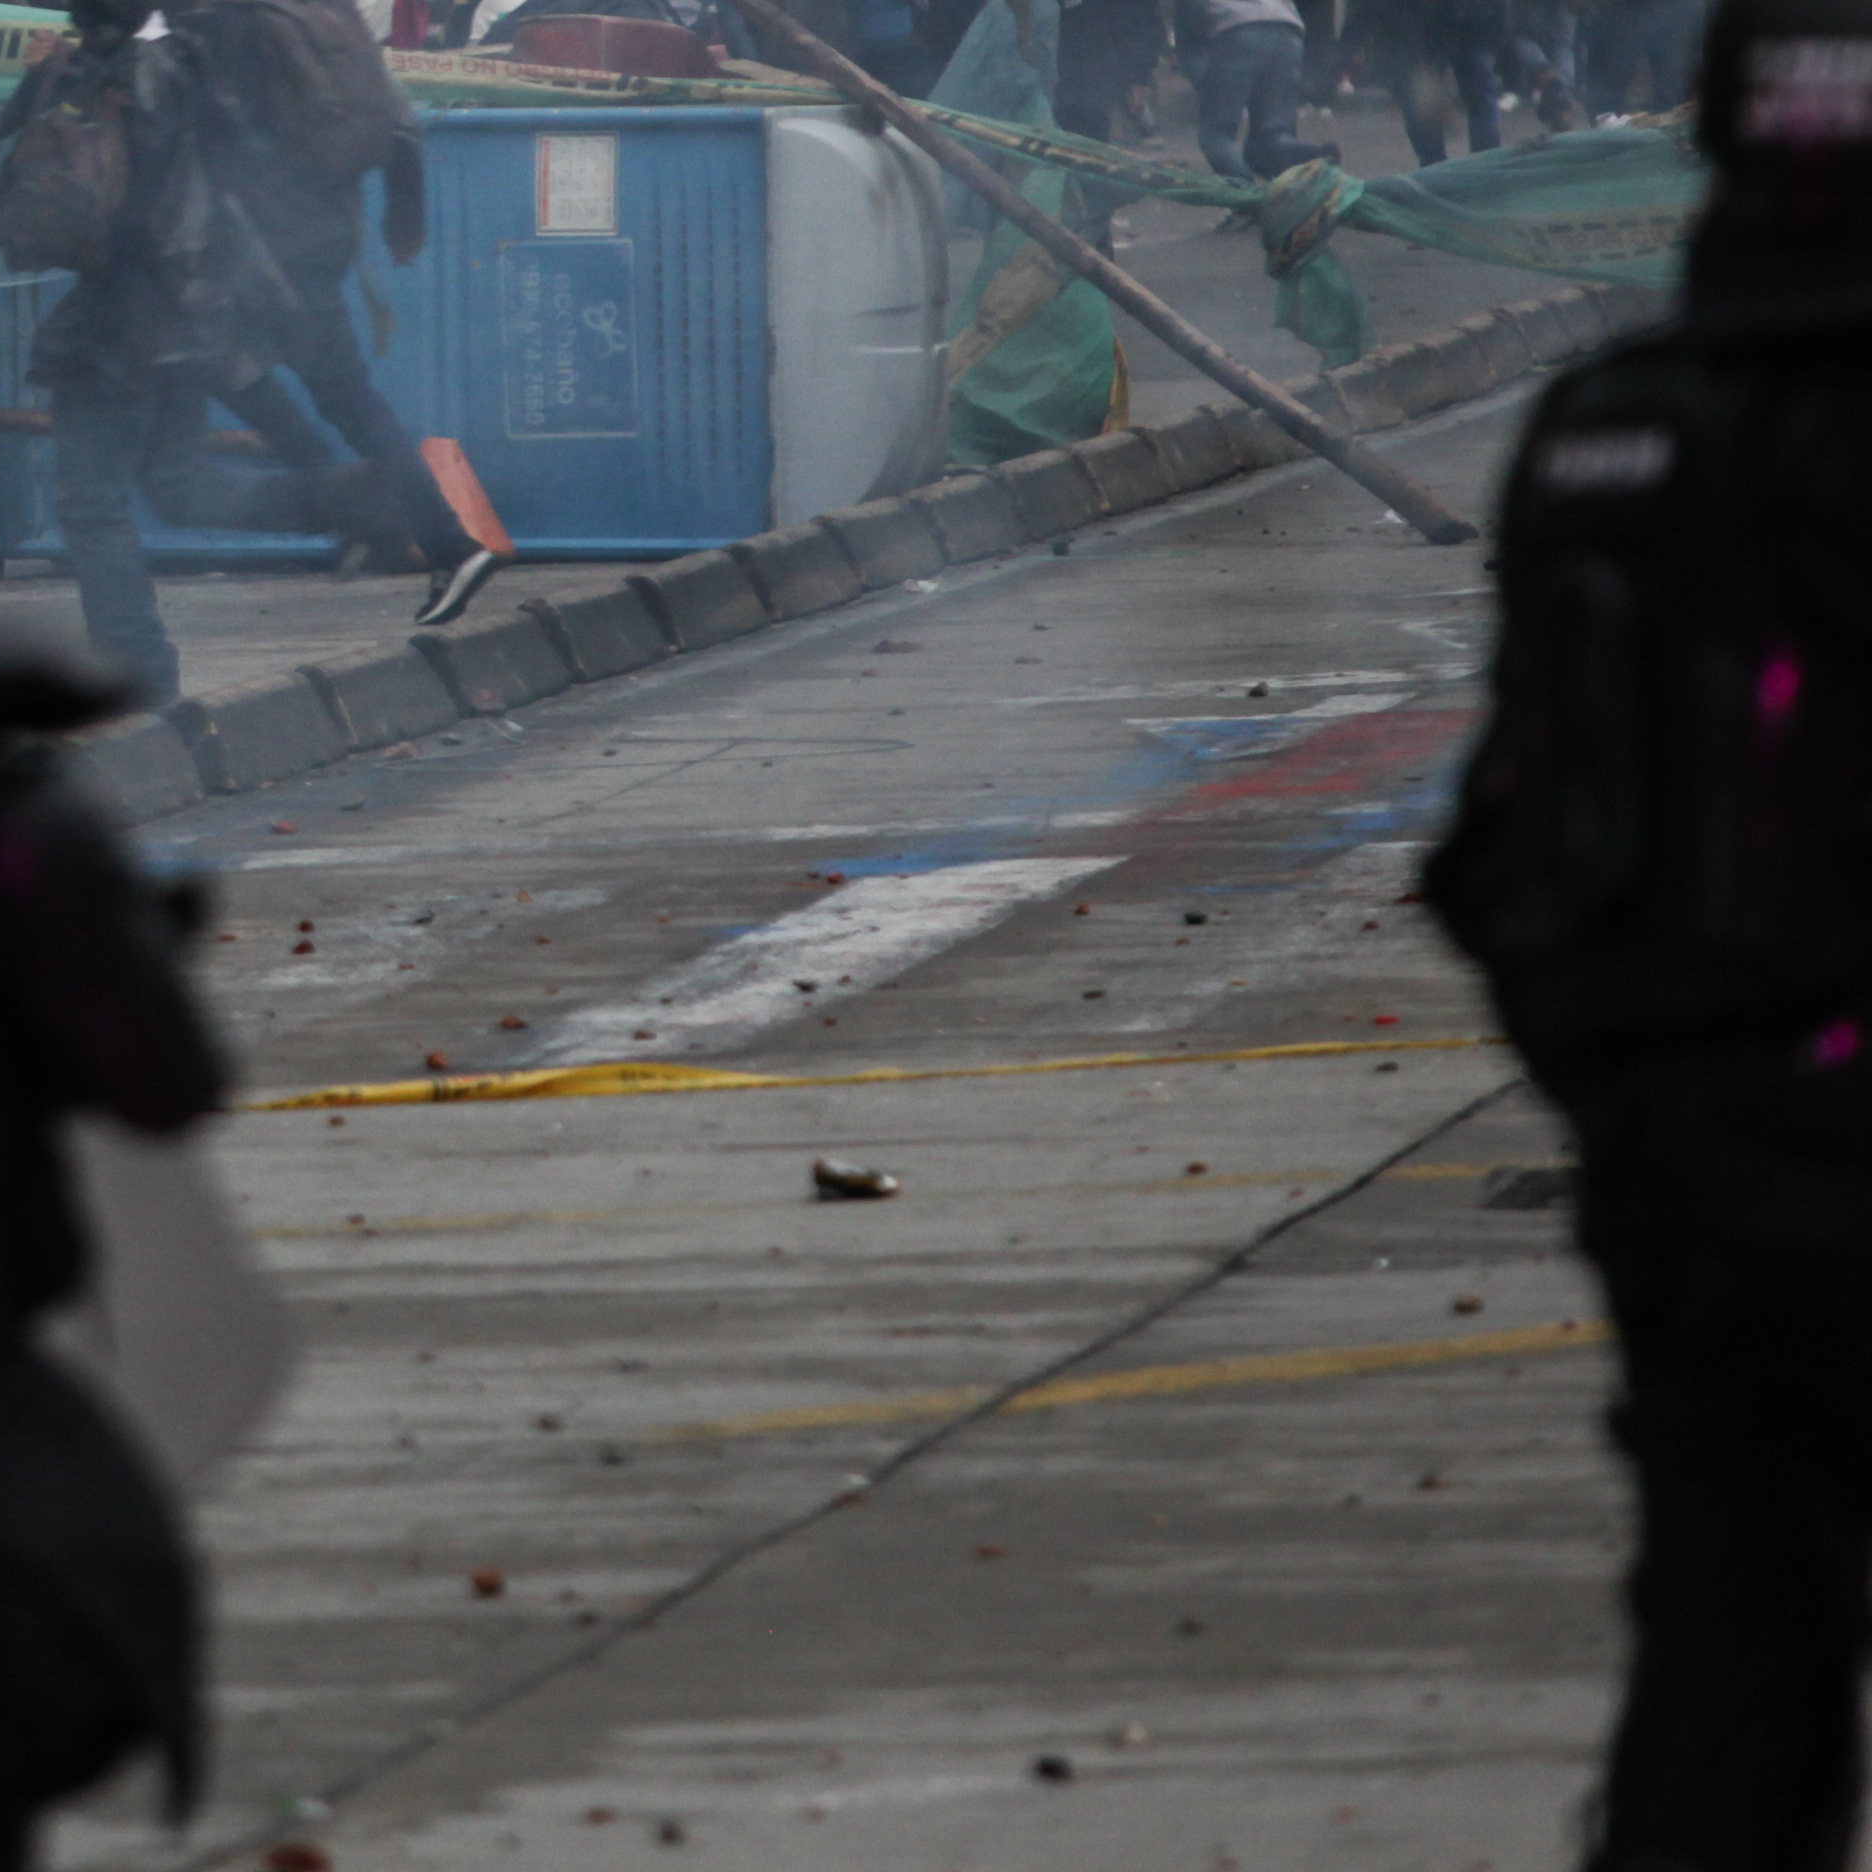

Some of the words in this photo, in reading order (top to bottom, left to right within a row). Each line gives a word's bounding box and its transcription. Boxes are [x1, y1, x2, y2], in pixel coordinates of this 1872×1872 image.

[392, 54, 454, 73] PASE
[462, 58, 497, 76] NO
[553, 272, 581, 406] ecobaño
